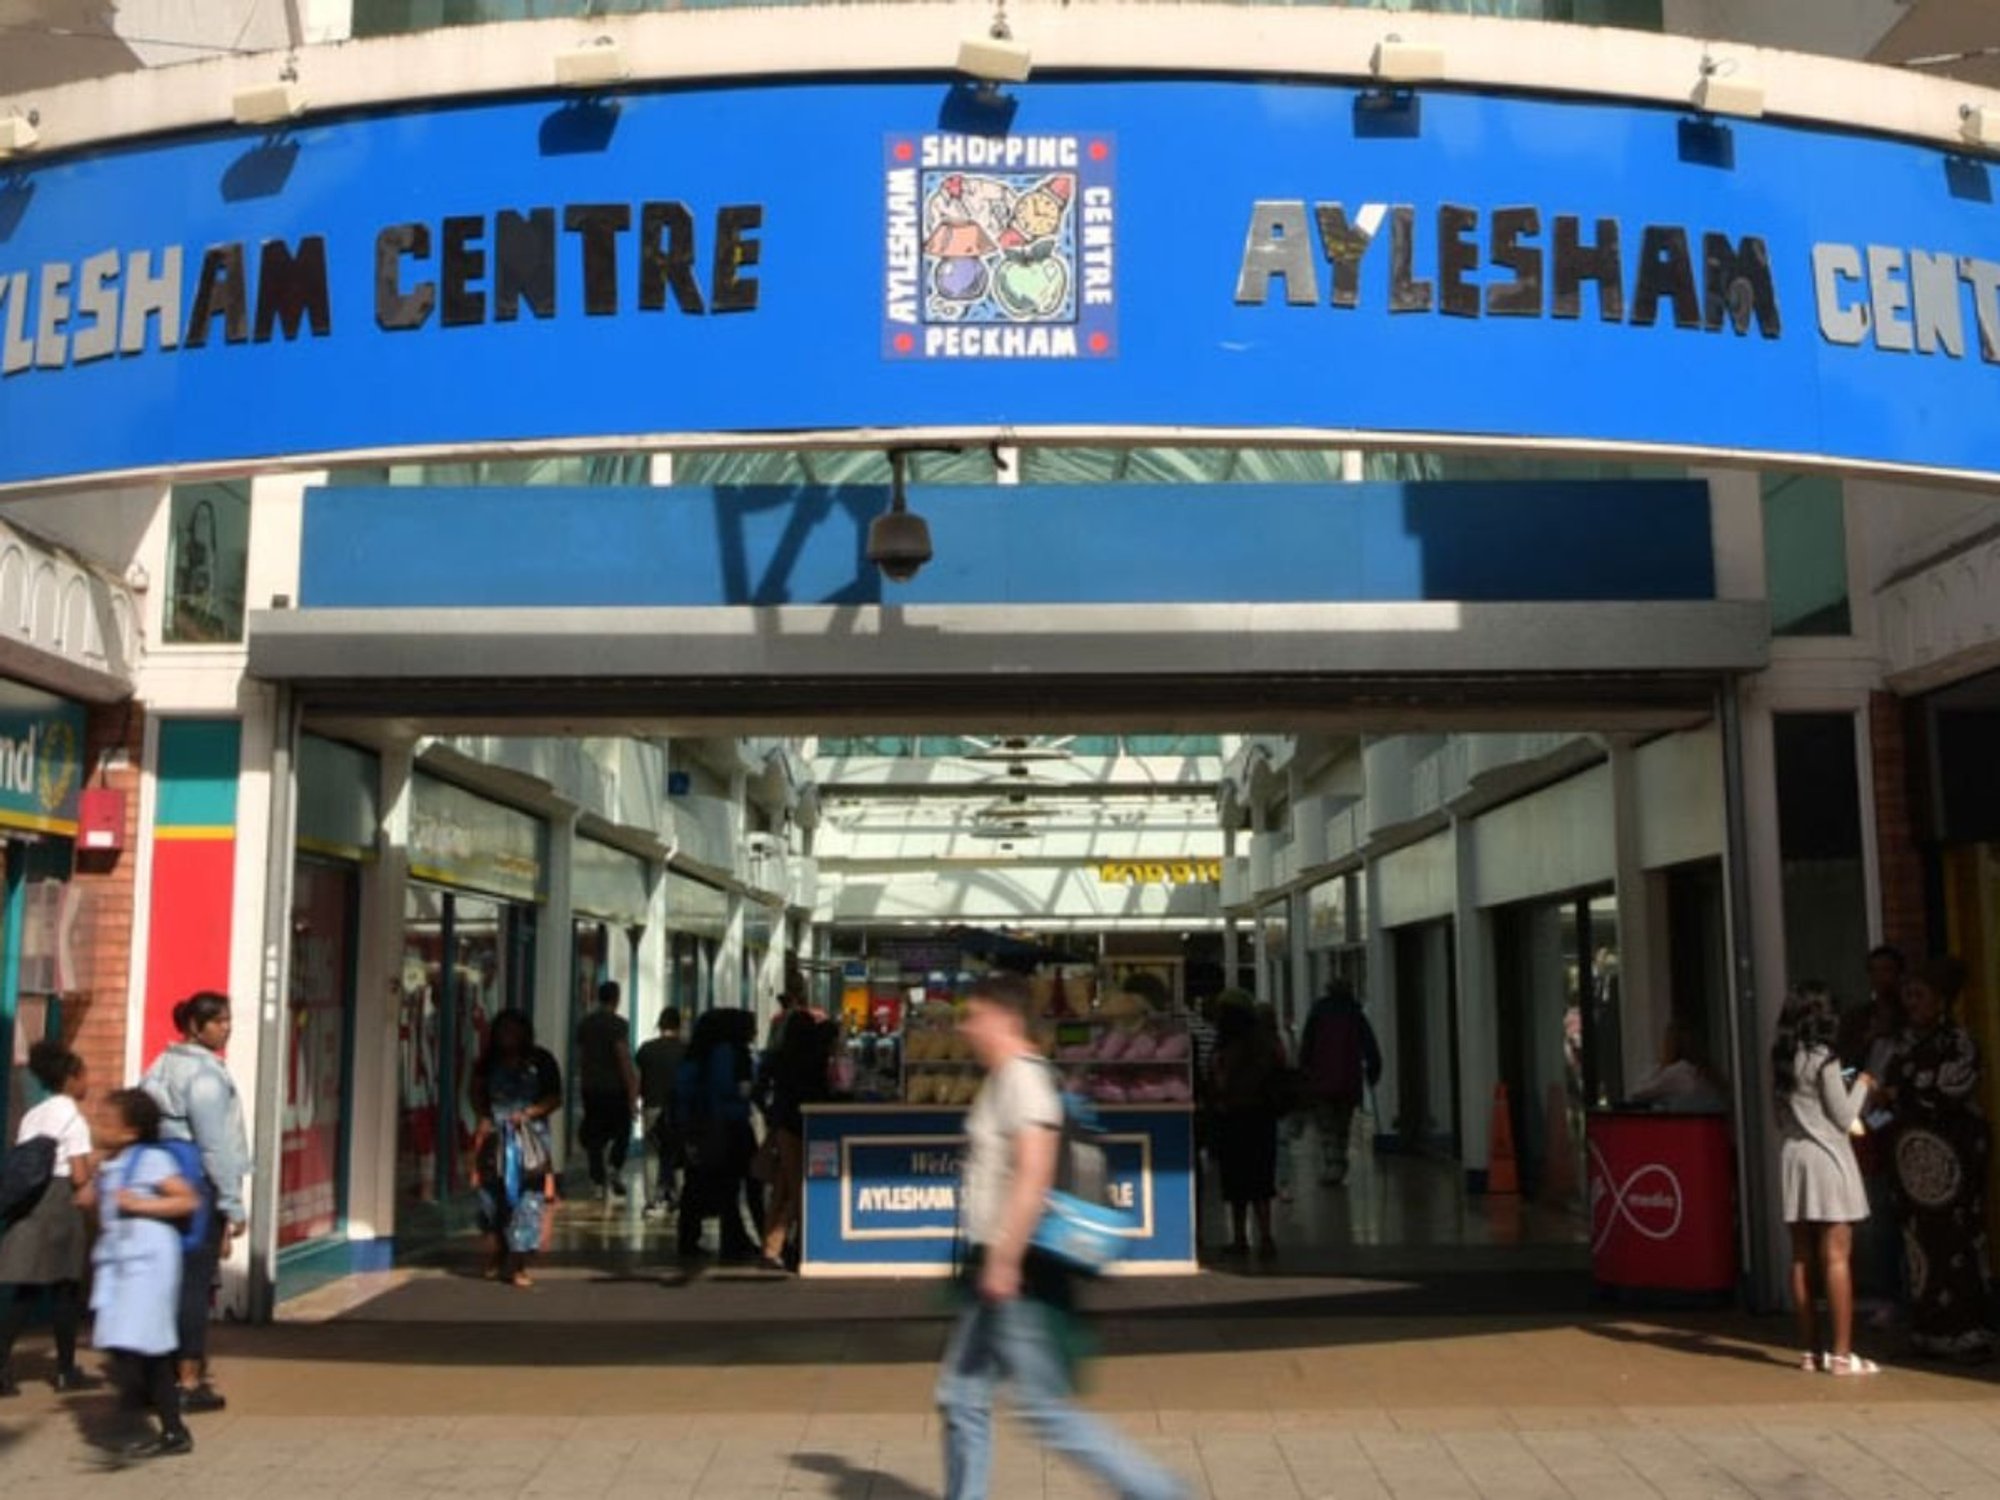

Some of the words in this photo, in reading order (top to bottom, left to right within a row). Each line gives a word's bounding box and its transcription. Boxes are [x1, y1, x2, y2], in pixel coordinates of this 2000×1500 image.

[922, 135, 1078, 167] SHOPPING
[374, 201, 763, 332] CENTRE
[886, 167, 918, 324] AYLESHAM
[1083, 186, 1112, 304] CENTRE
[1234, 200, 1781, 339] AYLESHAM
[1811, 241, 2000, 367] CENT
[924, 327, 1078, 358] PECKHAM
